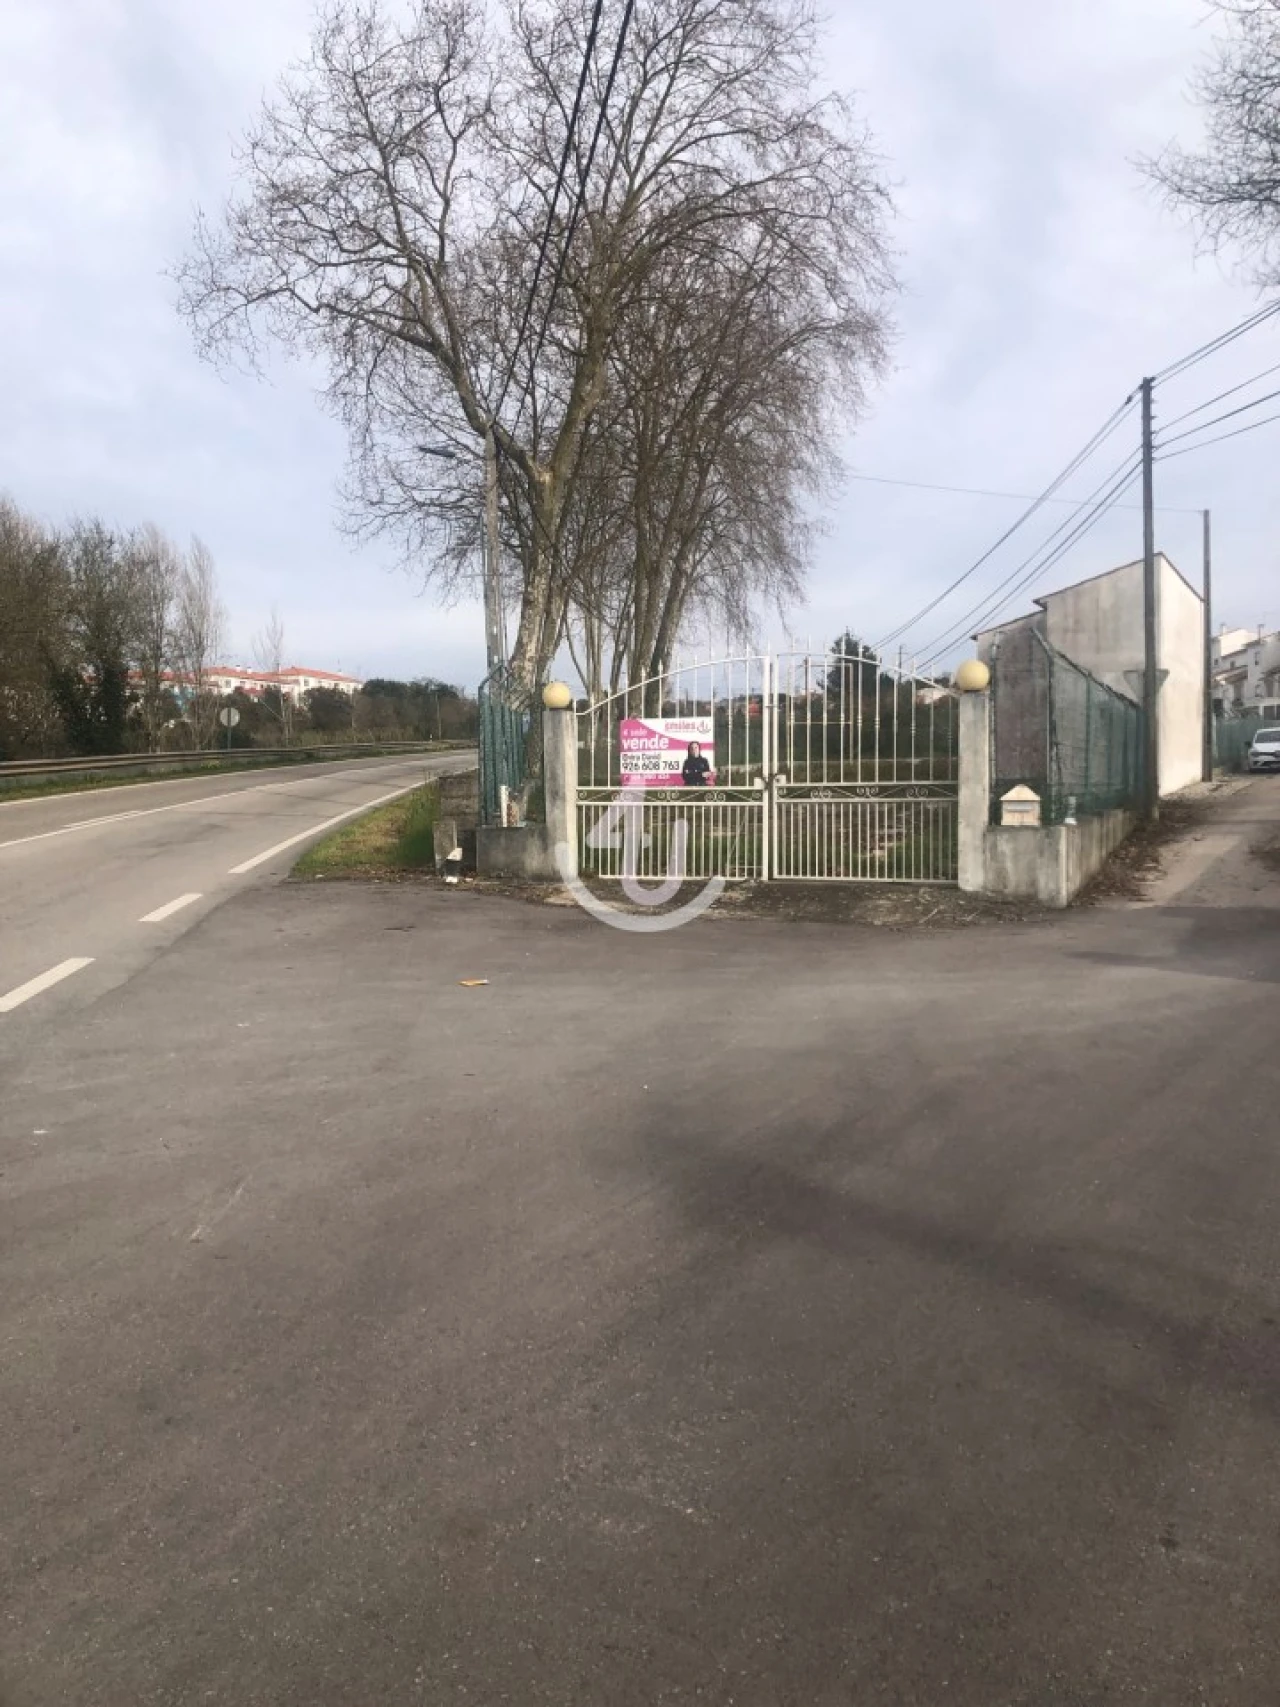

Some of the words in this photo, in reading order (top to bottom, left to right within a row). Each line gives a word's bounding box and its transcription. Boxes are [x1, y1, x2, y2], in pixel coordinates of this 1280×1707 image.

[622, 734, 669, 750] vende
[621, 761, 641, 772] 926
[641, 760, 661, 771] 608
[662, 760, 680, 771] 763
